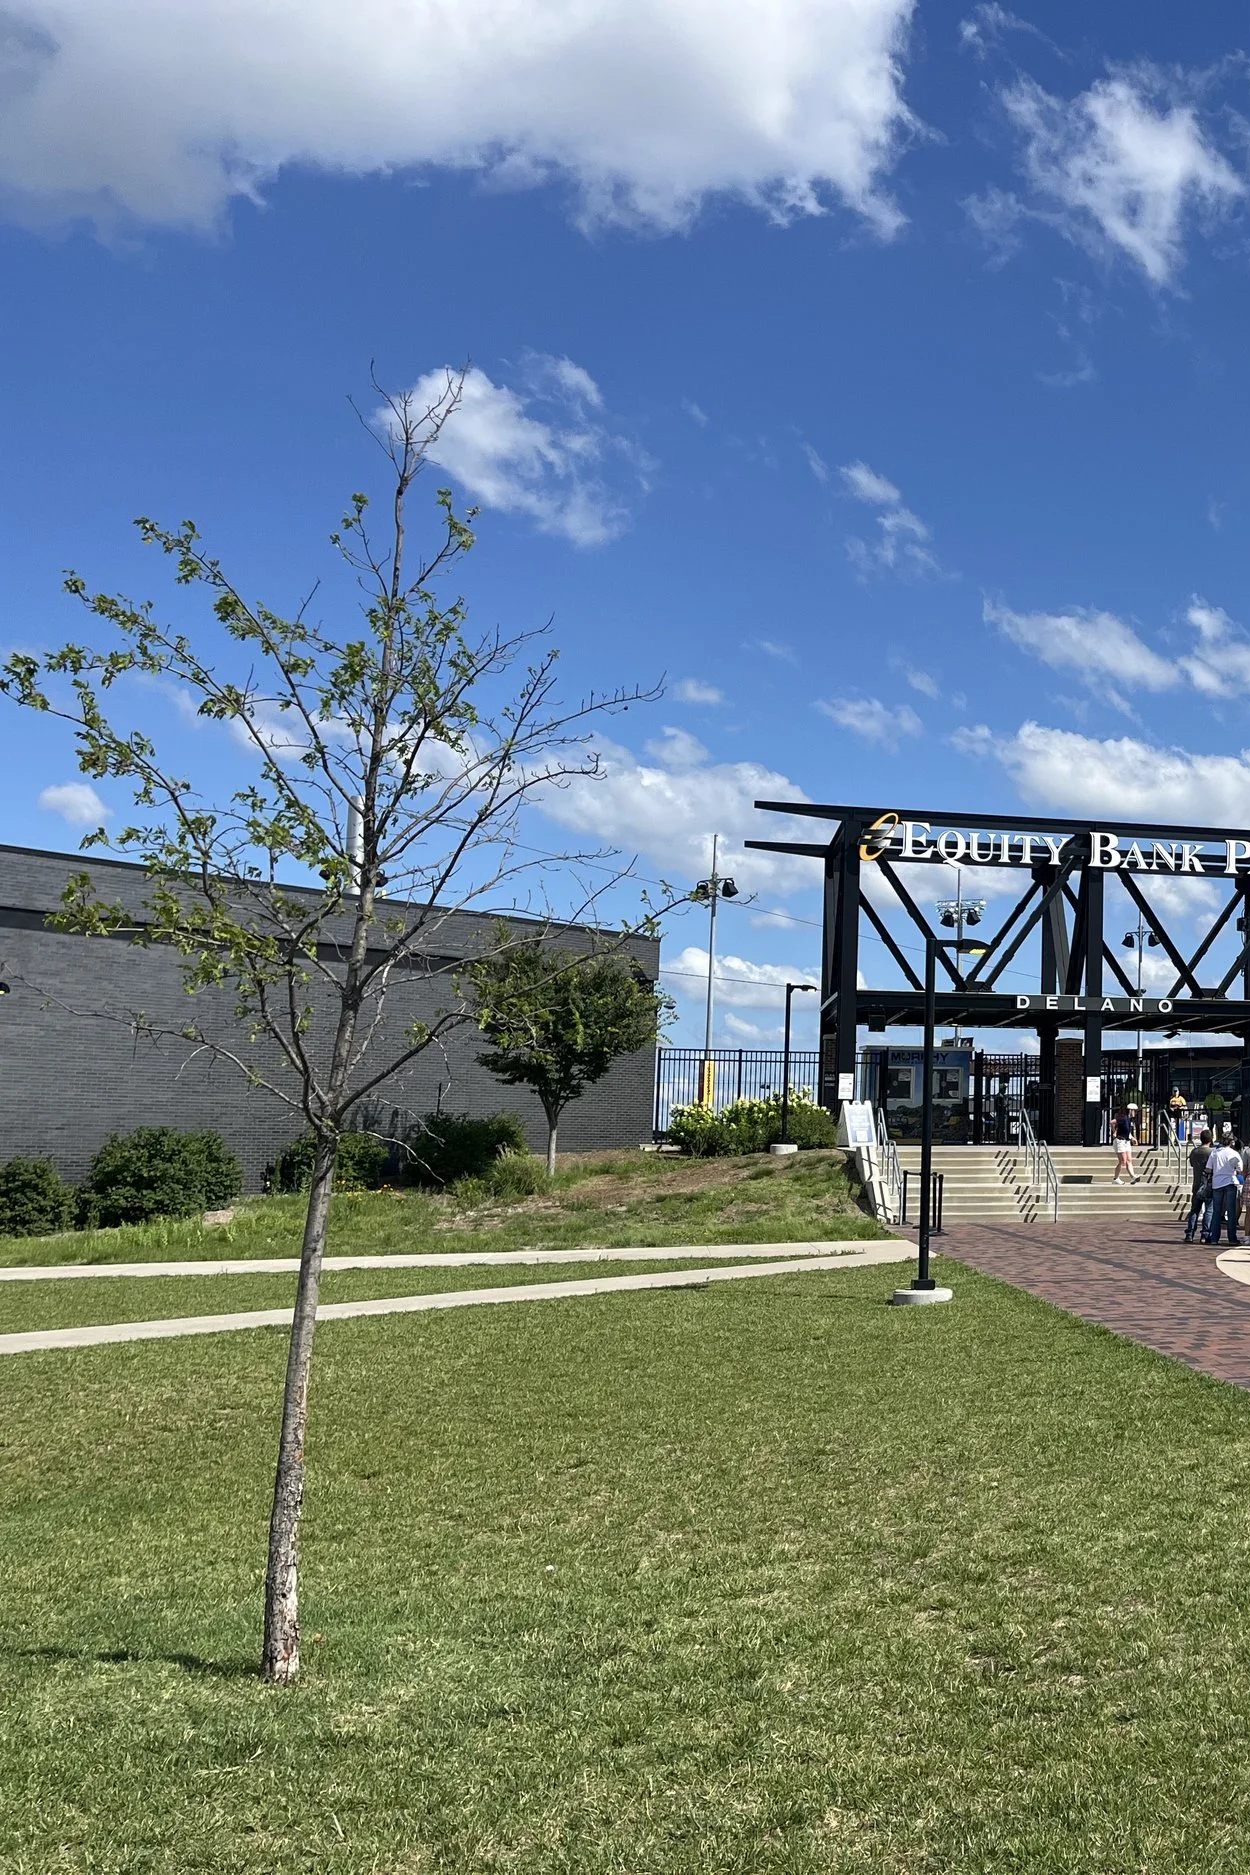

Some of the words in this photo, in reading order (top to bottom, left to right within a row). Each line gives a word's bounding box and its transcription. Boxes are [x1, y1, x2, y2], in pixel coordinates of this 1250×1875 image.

[899, 820, 1071, 870] EQUITY
[1088, 831, 1205, 873] BANK
[1016, 995, 1173, 1013] DELANO
